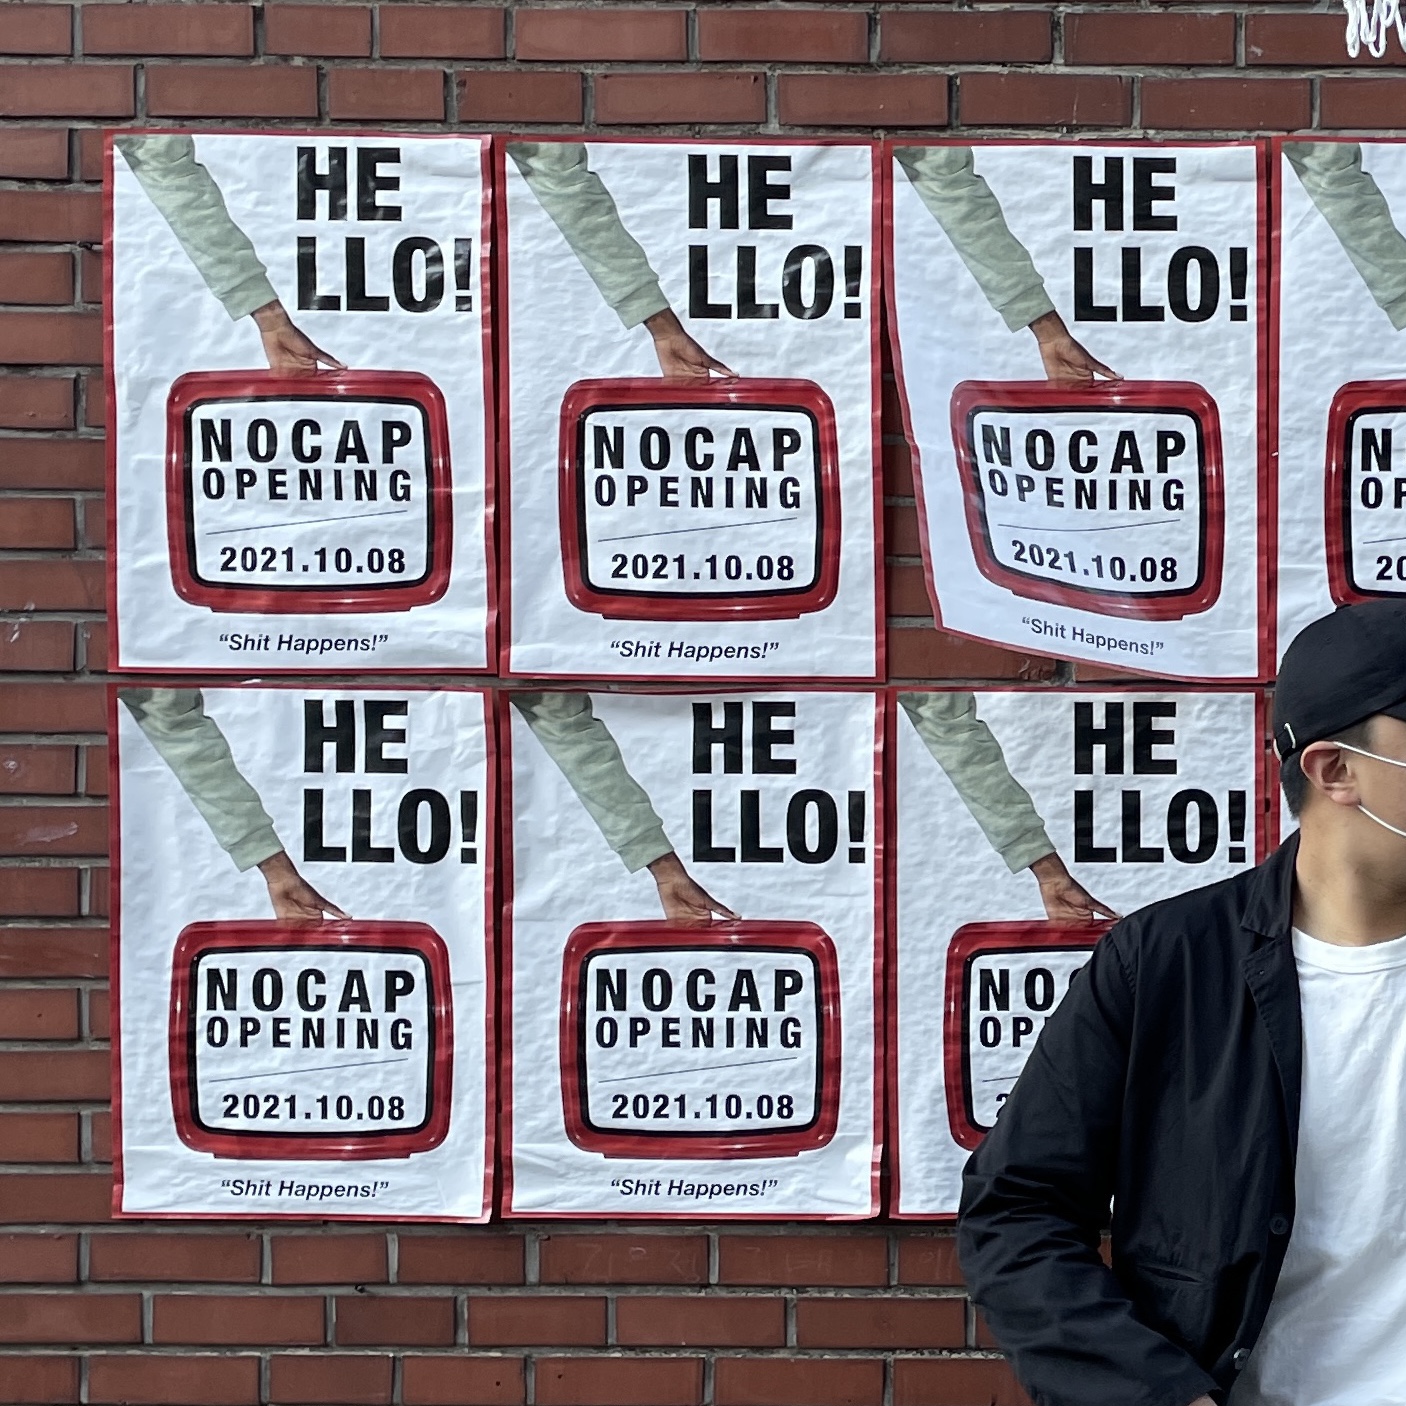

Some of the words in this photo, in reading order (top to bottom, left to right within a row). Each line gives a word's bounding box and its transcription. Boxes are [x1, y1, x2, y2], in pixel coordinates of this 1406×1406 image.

[297, 147, 402, 221] HE
[688, 154, 793, 230] HE
[1074, 156, 1177, 231] HE
[297, 237, 472, 312] LLO!
[689, 245, 862, 319] LLO!
[1074, 246, 1247, 322] LLO!
[200, 419, 411, 464] NOCAP
[594, 426, 801, 471] NOCAP
[982, 424, 1186, 474] NOCAP
[203, 468, 410, 501] OPENING
[595, 475, 800, 508] OPENING
[988, 469, 1185, 511] OPENING
[221, 547, 405, 573] 2021.10.08
[611, 554, 794, 580] 2021.10.08
[1011, 540, 1178, 583] 2021.10.08
[304, 700, 408, 774] HE
[692, 701, 796, 774] HE
[1074, 702, 1177, 775] HE
[304, 789, 477, 864] LLO!
[693, 789, 865, 864] LLO!
[1075, 789, 1246, 863] LLO!
[207, 968, 414, 1012] NOCAP
[596, 968, 803, 1012] NOCAP
[207, 1016, 412, 1050] OPENING
[596, 1017, 801, 1048] OPENING
[223, 1094, 404, 1120] 2021.10.08
[612, 1094, 793, 1119] 2021.10.08
